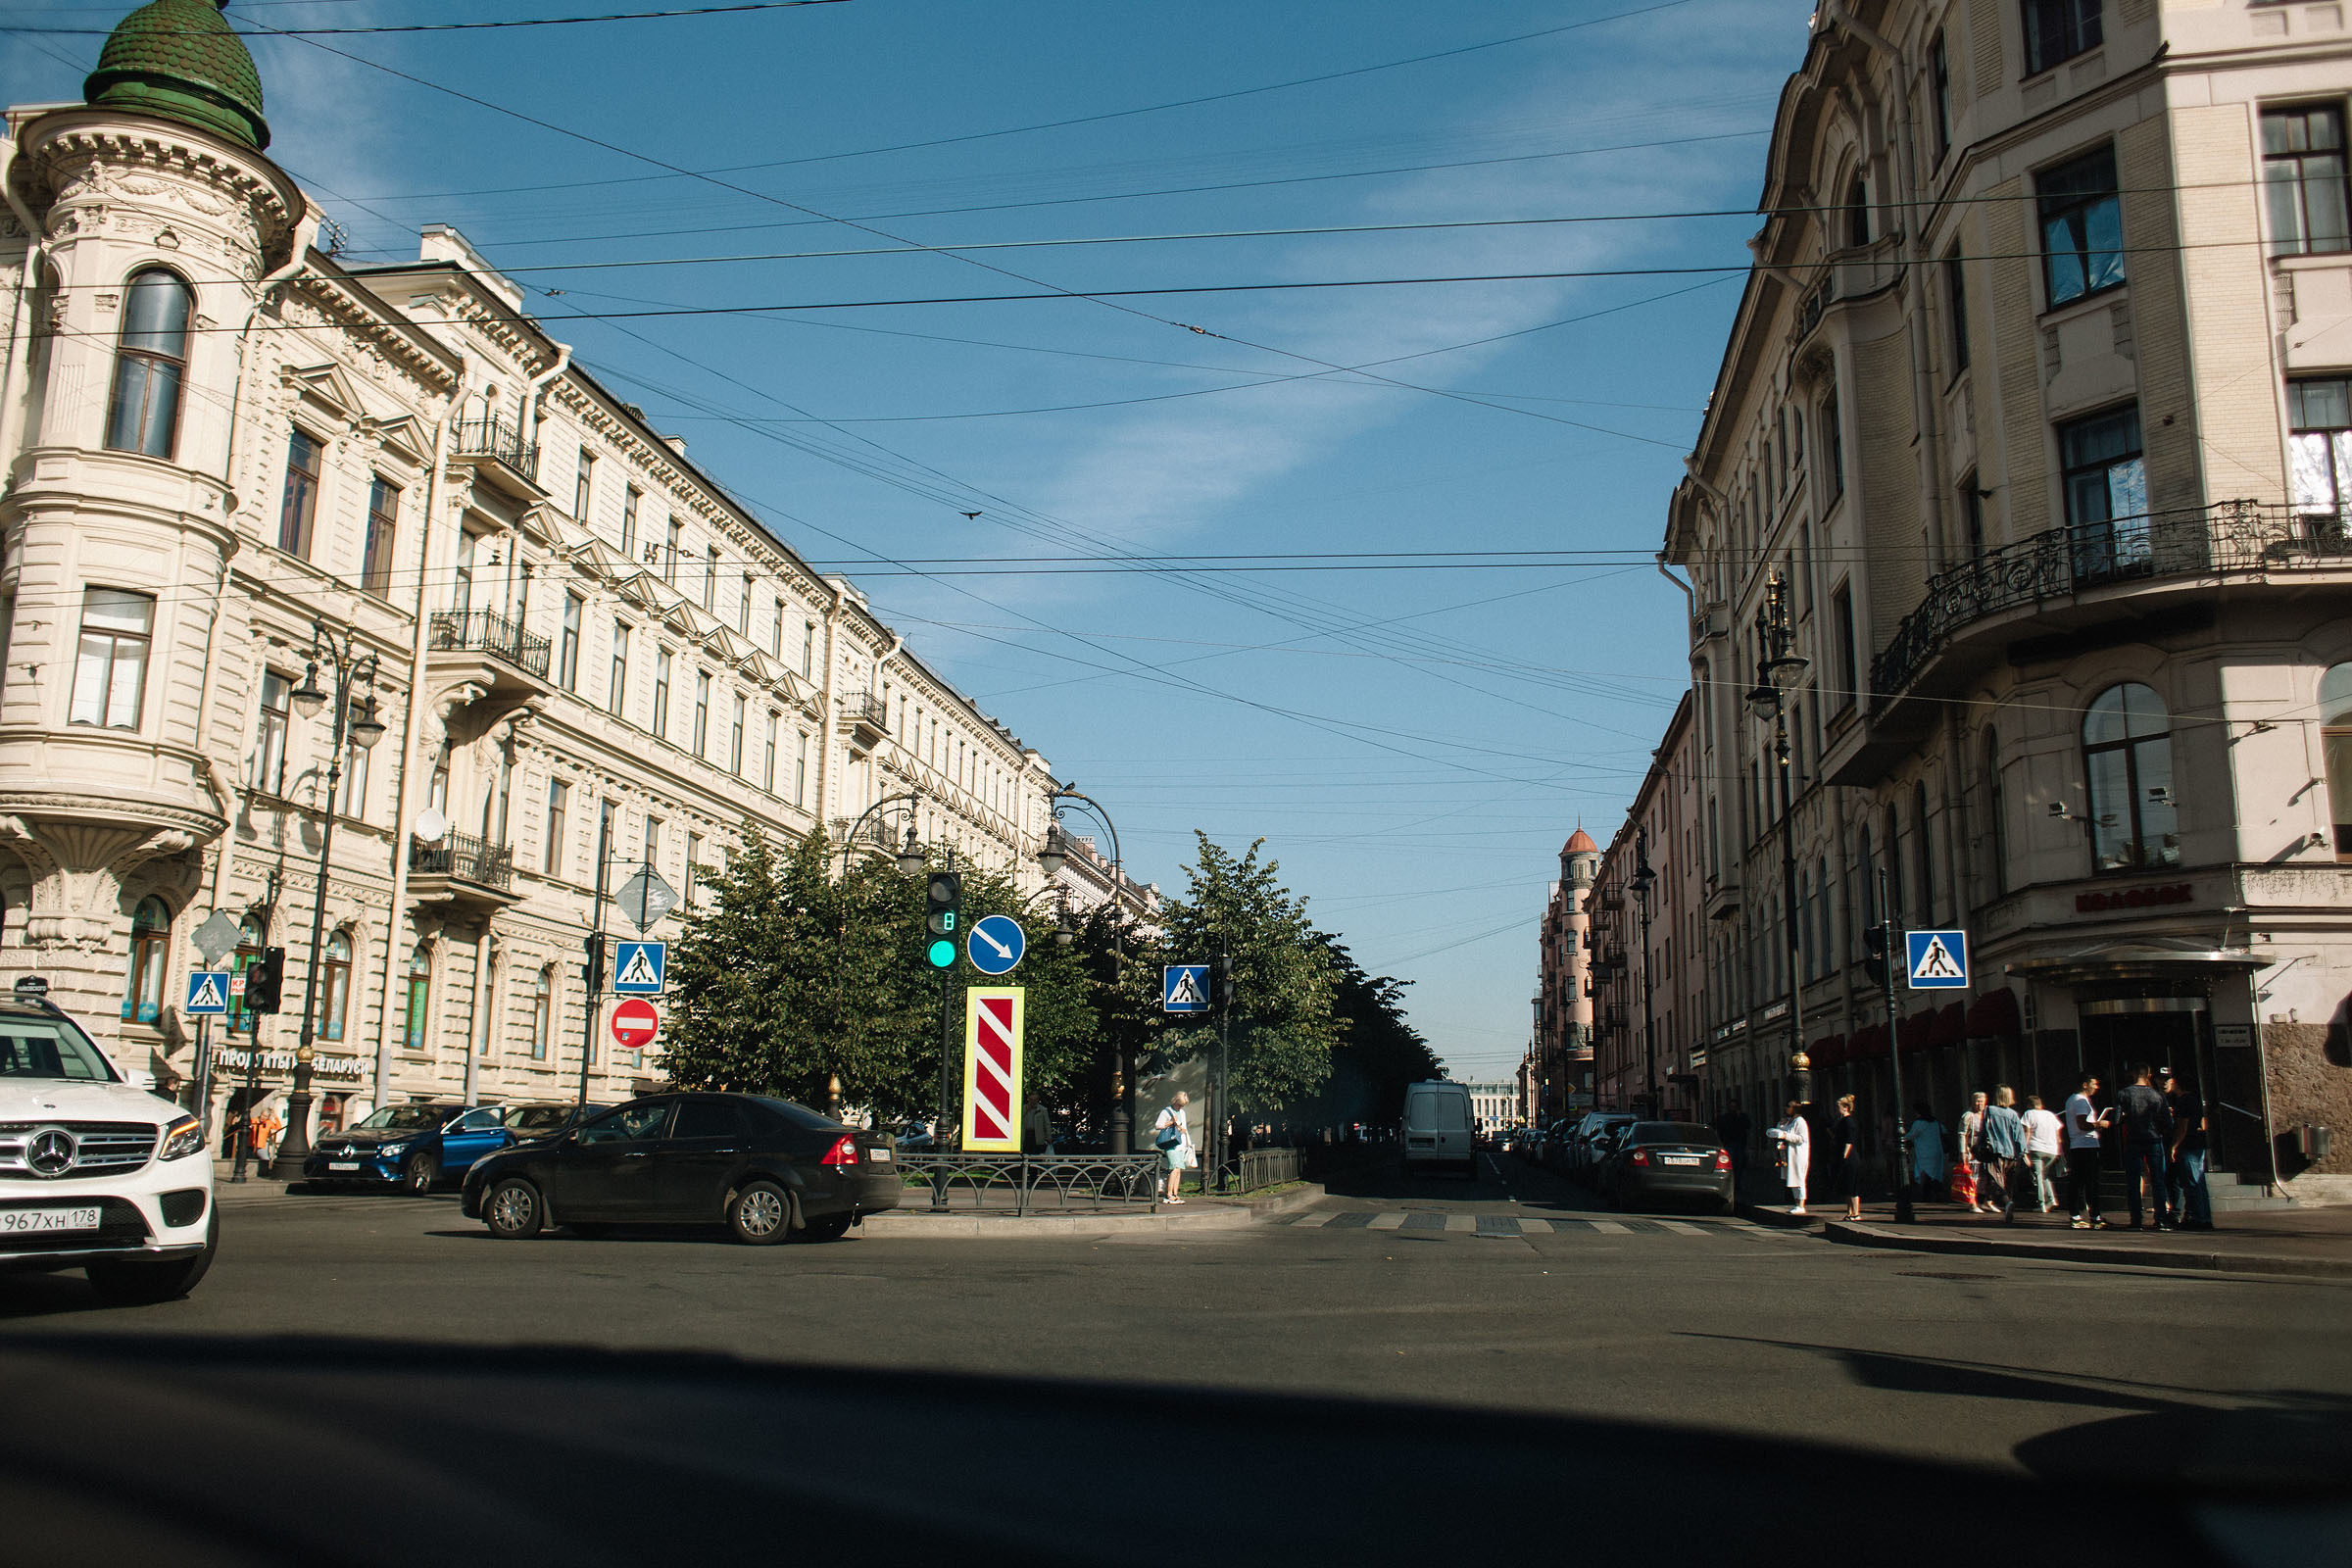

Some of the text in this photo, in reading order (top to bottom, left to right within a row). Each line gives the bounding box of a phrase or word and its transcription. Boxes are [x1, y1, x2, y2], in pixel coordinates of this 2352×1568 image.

[944, 912, 955, 931] 8
[311, 1056, 369, 1075] БЕЛАРУСИ
[0, 1209, 96, 1231] 967ХН 178
